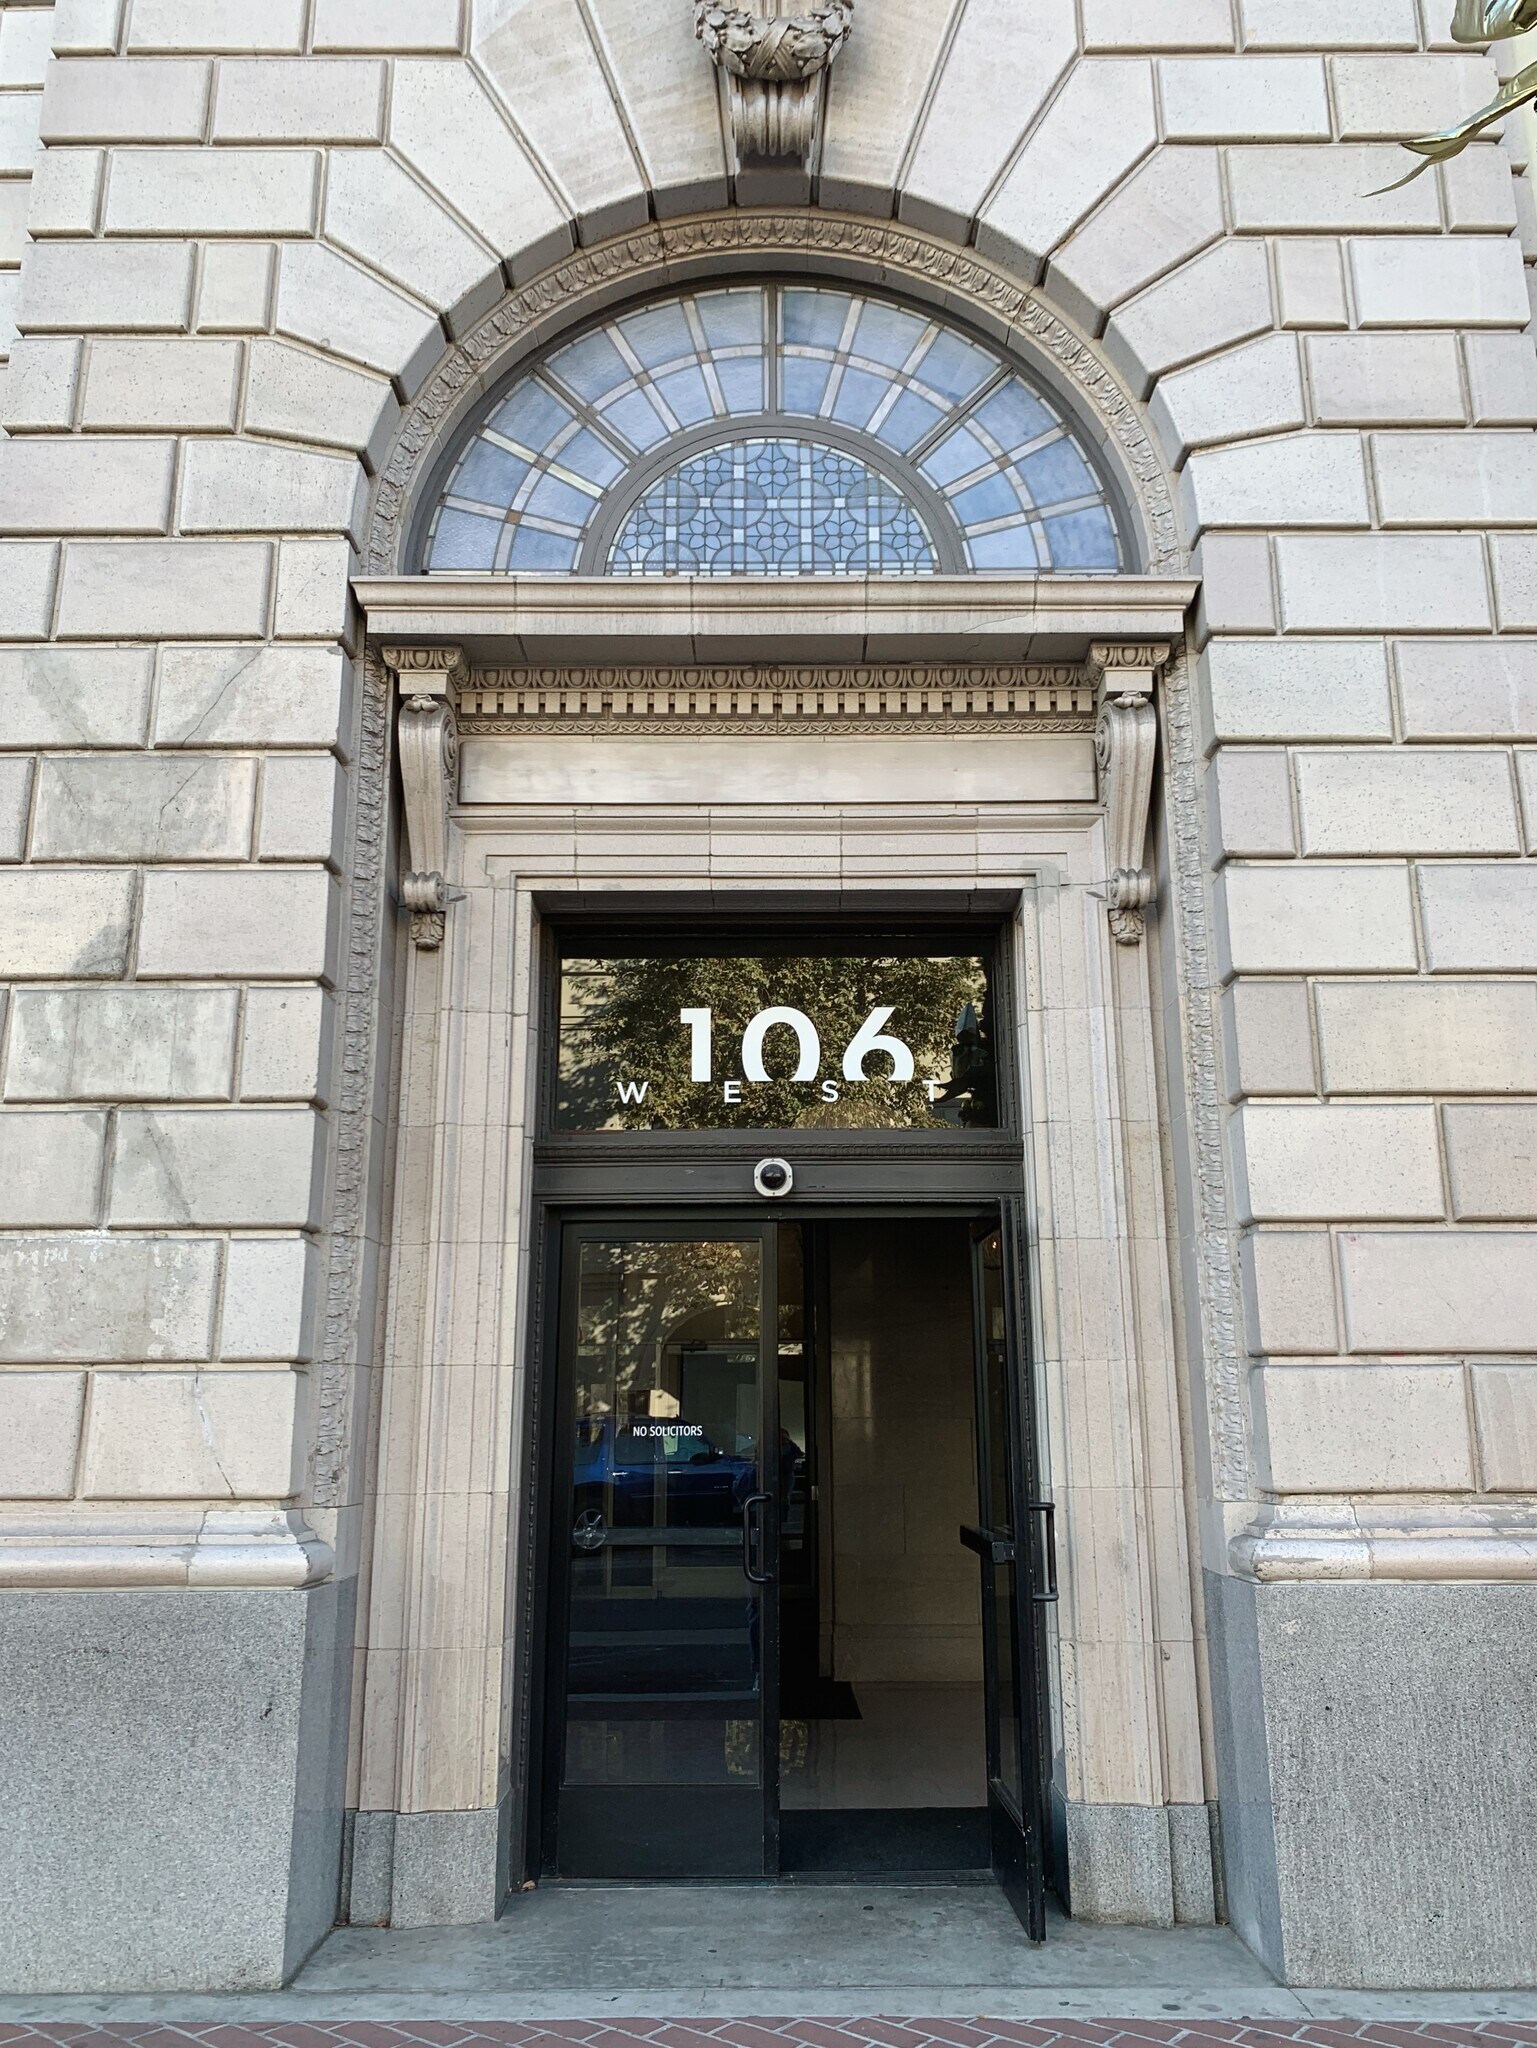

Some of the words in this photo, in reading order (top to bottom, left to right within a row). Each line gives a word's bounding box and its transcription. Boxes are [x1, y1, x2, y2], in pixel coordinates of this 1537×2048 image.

[680, 1006, 915, 1082] 106
[632, 1426, 647, 1437] NO
[649, 1425, 703, 1437] SOLICITORS
